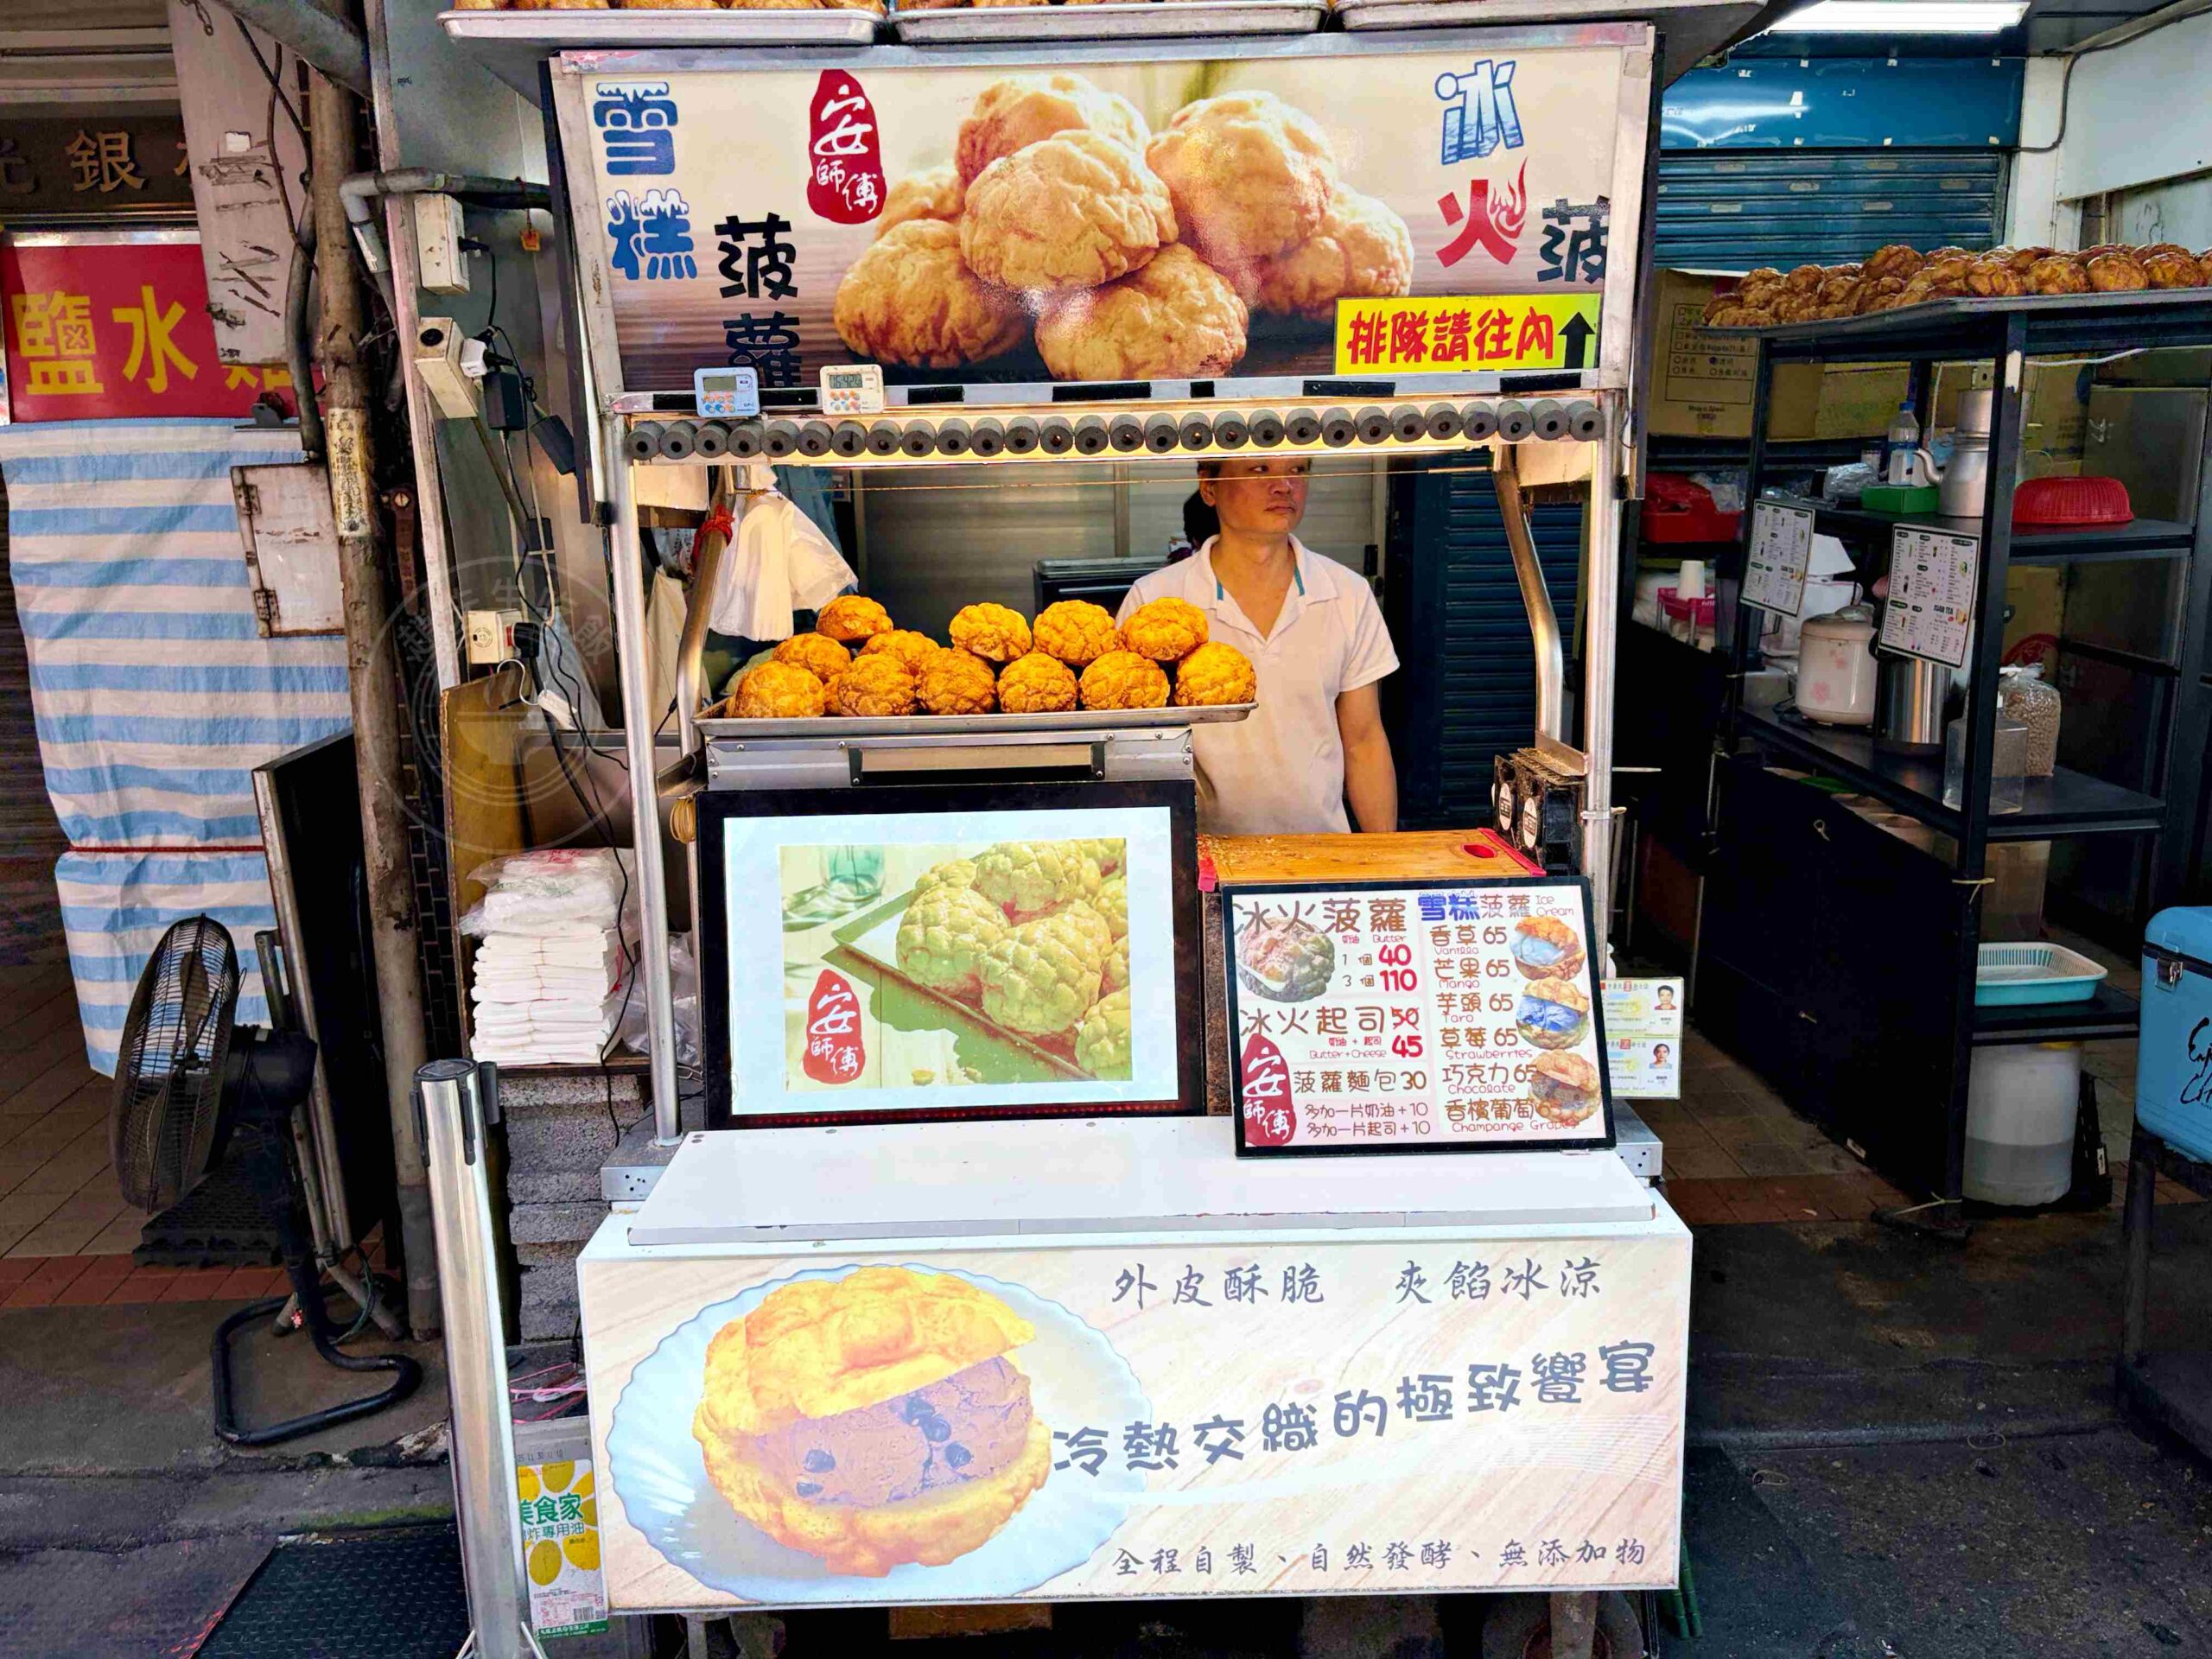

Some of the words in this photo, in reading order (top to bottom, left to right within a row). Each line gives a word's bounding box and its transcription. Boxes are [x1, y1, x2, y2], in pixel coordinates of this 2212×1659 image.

[812, 84, 879, 216] 安師傅
[593, 81, 697, 280] 雪糕
[1345, 304, 1555, 365] 排隊請往內
[1535, 895, 1554, 905] Ice
[1233, 898, 1407, 935] 冰火菠蘿
[1341, 935, 1359, 944] 奶油
[1372, 935, 1406, 944] Butter
[1429, 925, 1478, 947] 香草
[1483, 926, 1507, 945] 65
[1358, 953, 1373, 966] 個
[1379, 944, 1412, 967] 40
[1342, 975, 1351, 987] 3
[1360, 975, 1375, 988] 個
[1379, 969, 1417, 992] 110
[1433, 959, 1480, 981] 芒果
[1485, 959, 1510, 977] 65
[1439, 979, 1480, 989] Mango
[1436, 993, 1481, 1014] 芋頭
[1489, 993, 1514, 1012] 65
[1240, 1006, 1385, 1037] 冰火起司
[1441, 1014, 1474, 1023] Taro
[809, 983, 859, 1077] 安師傅
[1440, 1027, 1486, 1049] 草莓
[1494, 1027, 1518, 1047] 65
[1392, 1035, 1423, 1058] 45
[1446, 1049, 1533, 1059] Strawberries
[1294, 1069, 1396, 1094] 菠蘿麵包
[1401, 1071, 1427, 1090] 30
[1442, 1064, 1509, 1085] 巧克力
[1448, 1084, 1516, 1095] Chocolate
[1110, 1260, 1326, 1310] 外皮酥脆
[1394, 1256, 1603, 1305] 夾餡冰涼
[1052, 1339, 1656, 1477] 冷熱交織的極致饗宴
[522, 1522, 585, 1541] 炸專用油
